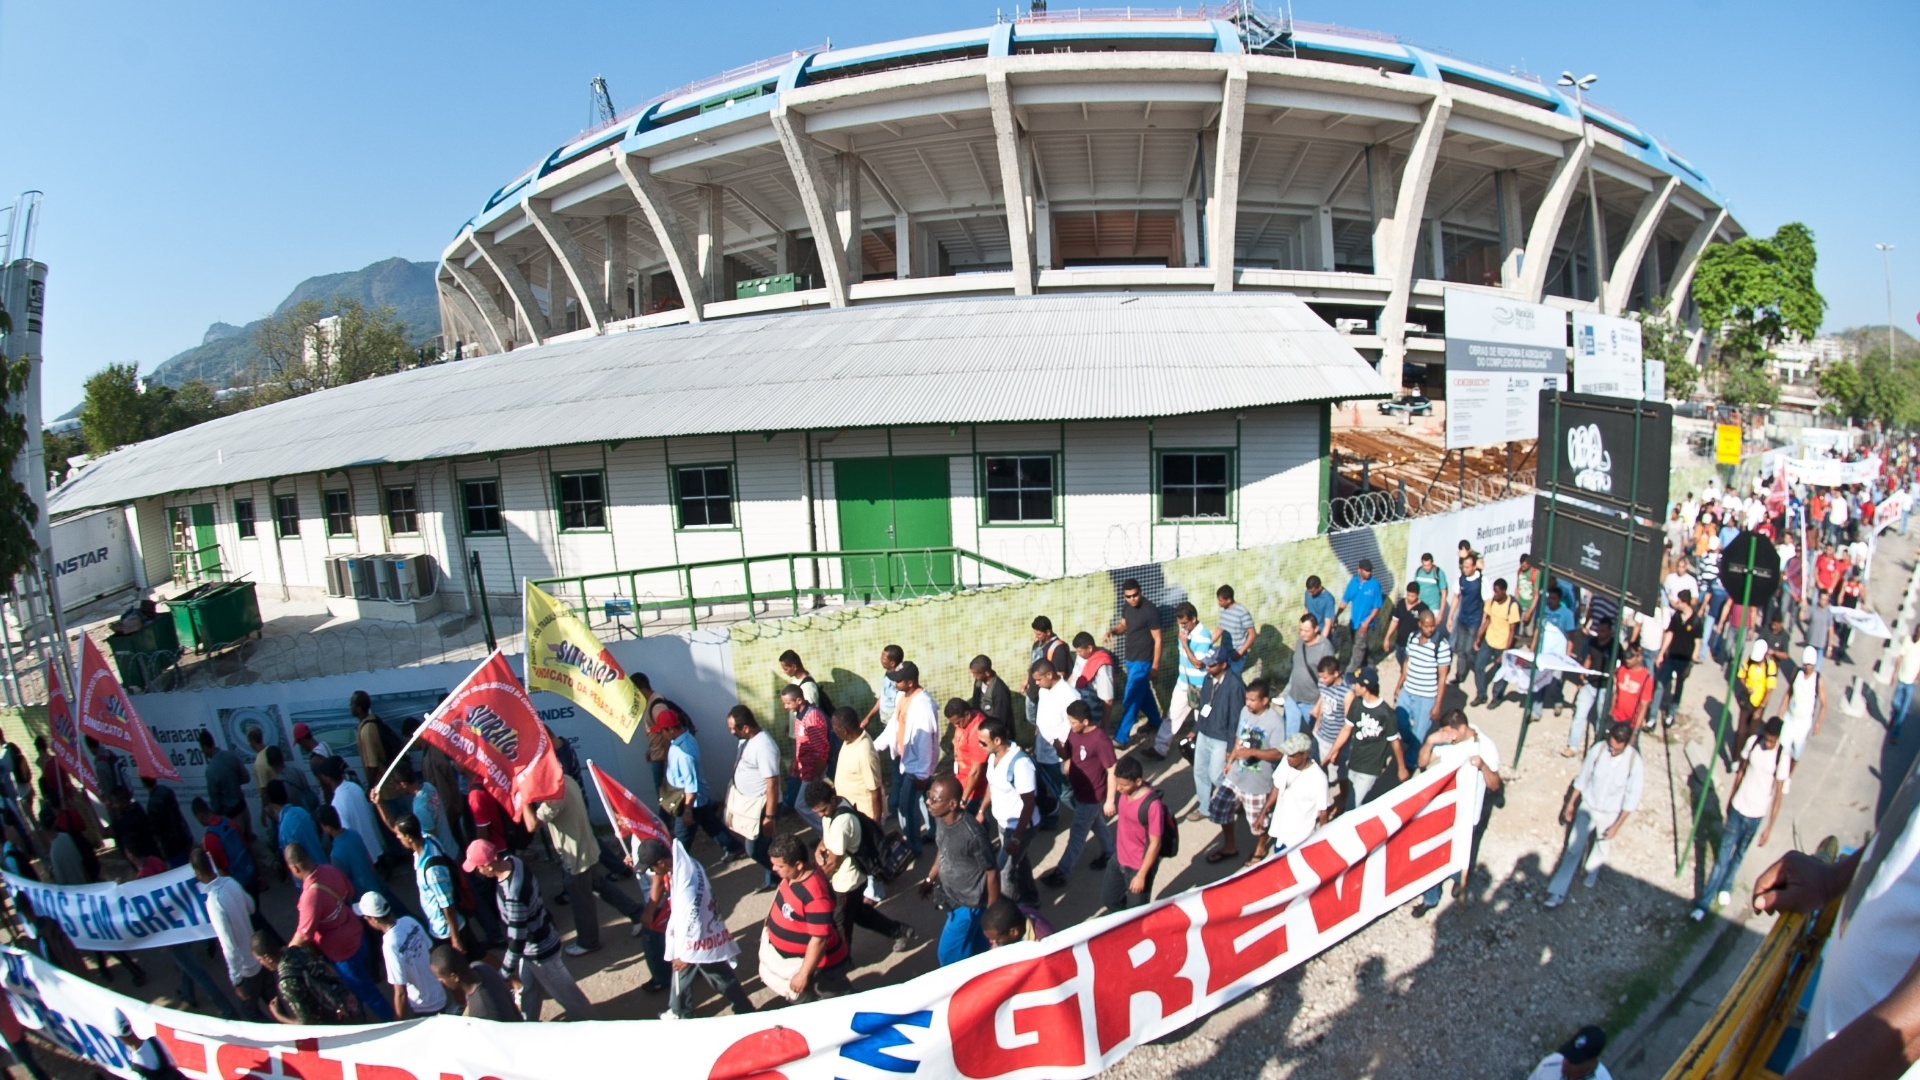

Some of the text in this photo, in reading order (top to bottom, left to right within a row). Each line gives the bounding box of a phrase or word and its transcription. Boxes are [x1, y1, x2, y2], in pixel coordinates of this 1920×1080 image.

[1477, 525, 1506, 540] Reforma
[1484, 543, 1500, 556] para
[1508, 536, 1524, 550] Copa
[147, 723, 206, 743] Maracan
[428, 719, 475, 755] SINDICATO
[77, 893, 123, 941] EM
[948, 768, 1458, 1080] GREVE
